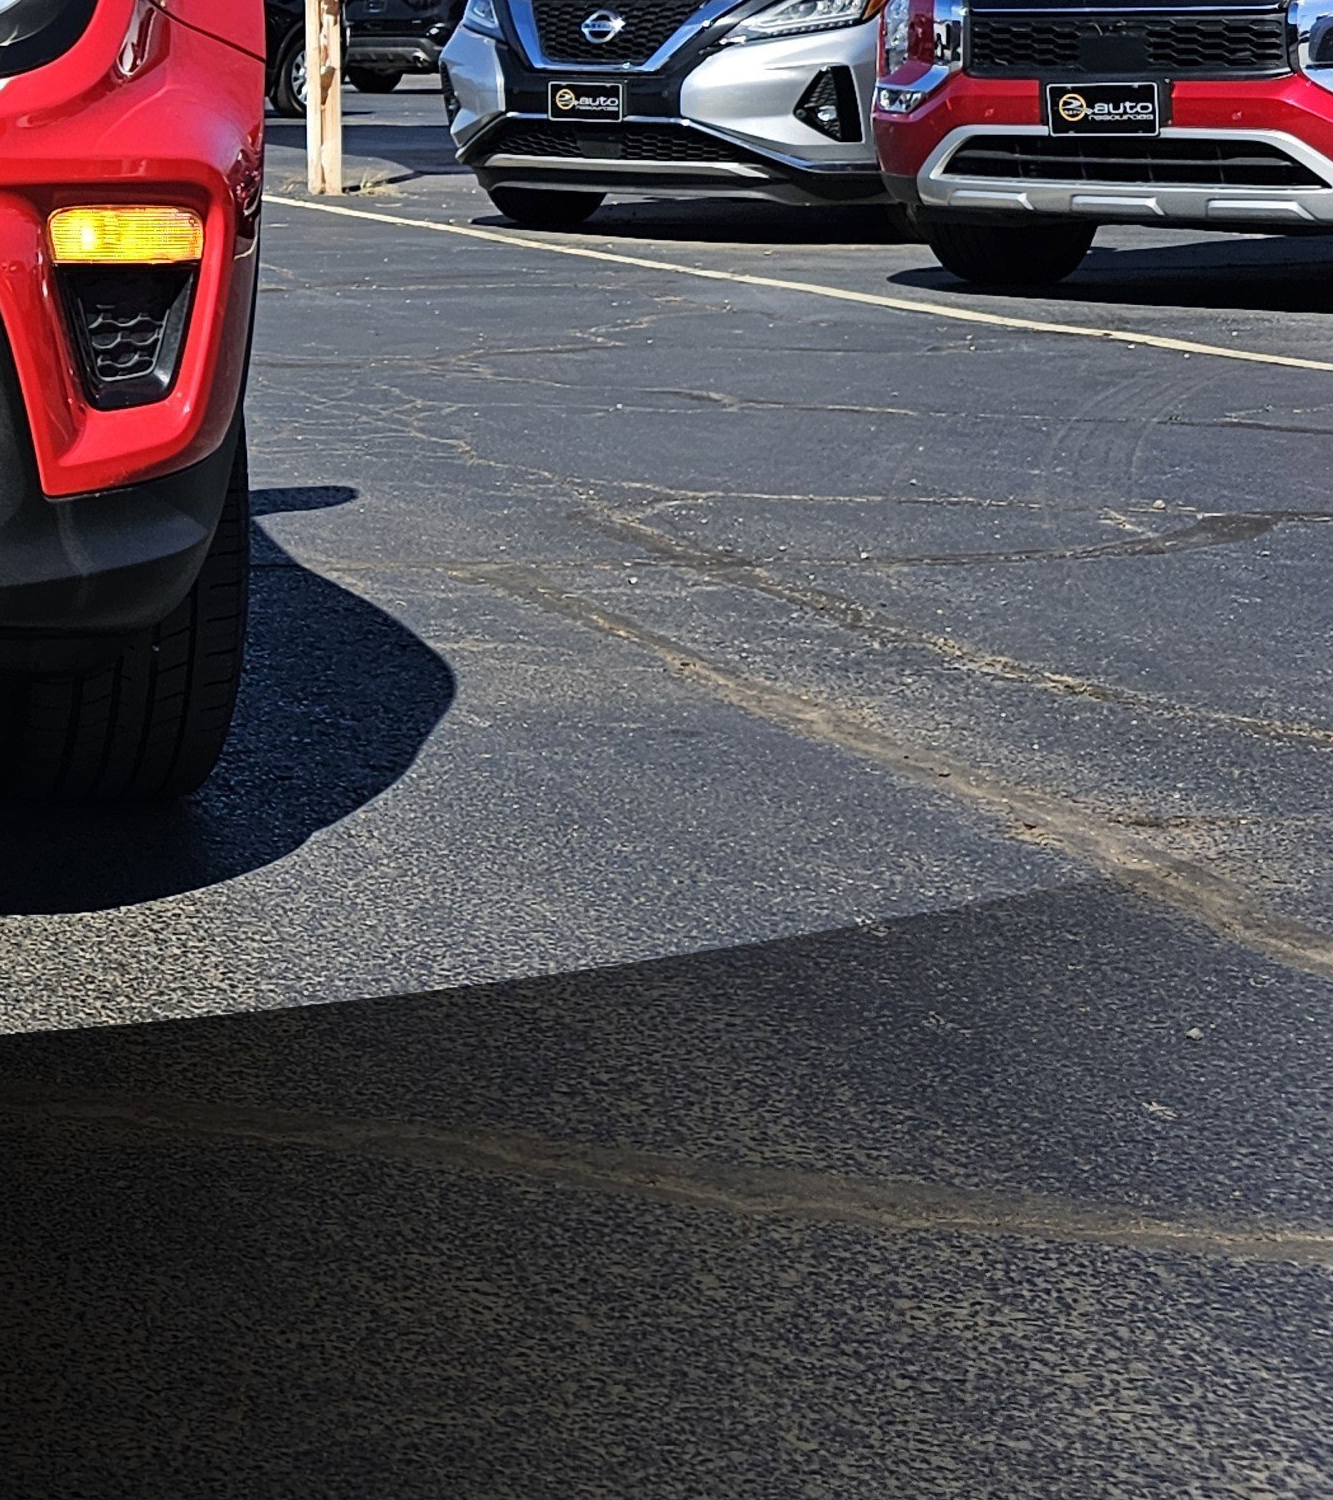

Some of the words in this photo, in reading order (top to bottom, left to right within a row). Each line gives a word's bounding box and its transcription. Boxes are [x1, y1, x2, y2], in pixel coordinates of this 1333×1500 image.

[579, 95, 619, 106] auto
[1094, 101, 1153, 114] auto
[1088, 113, 1154, 121] resources
